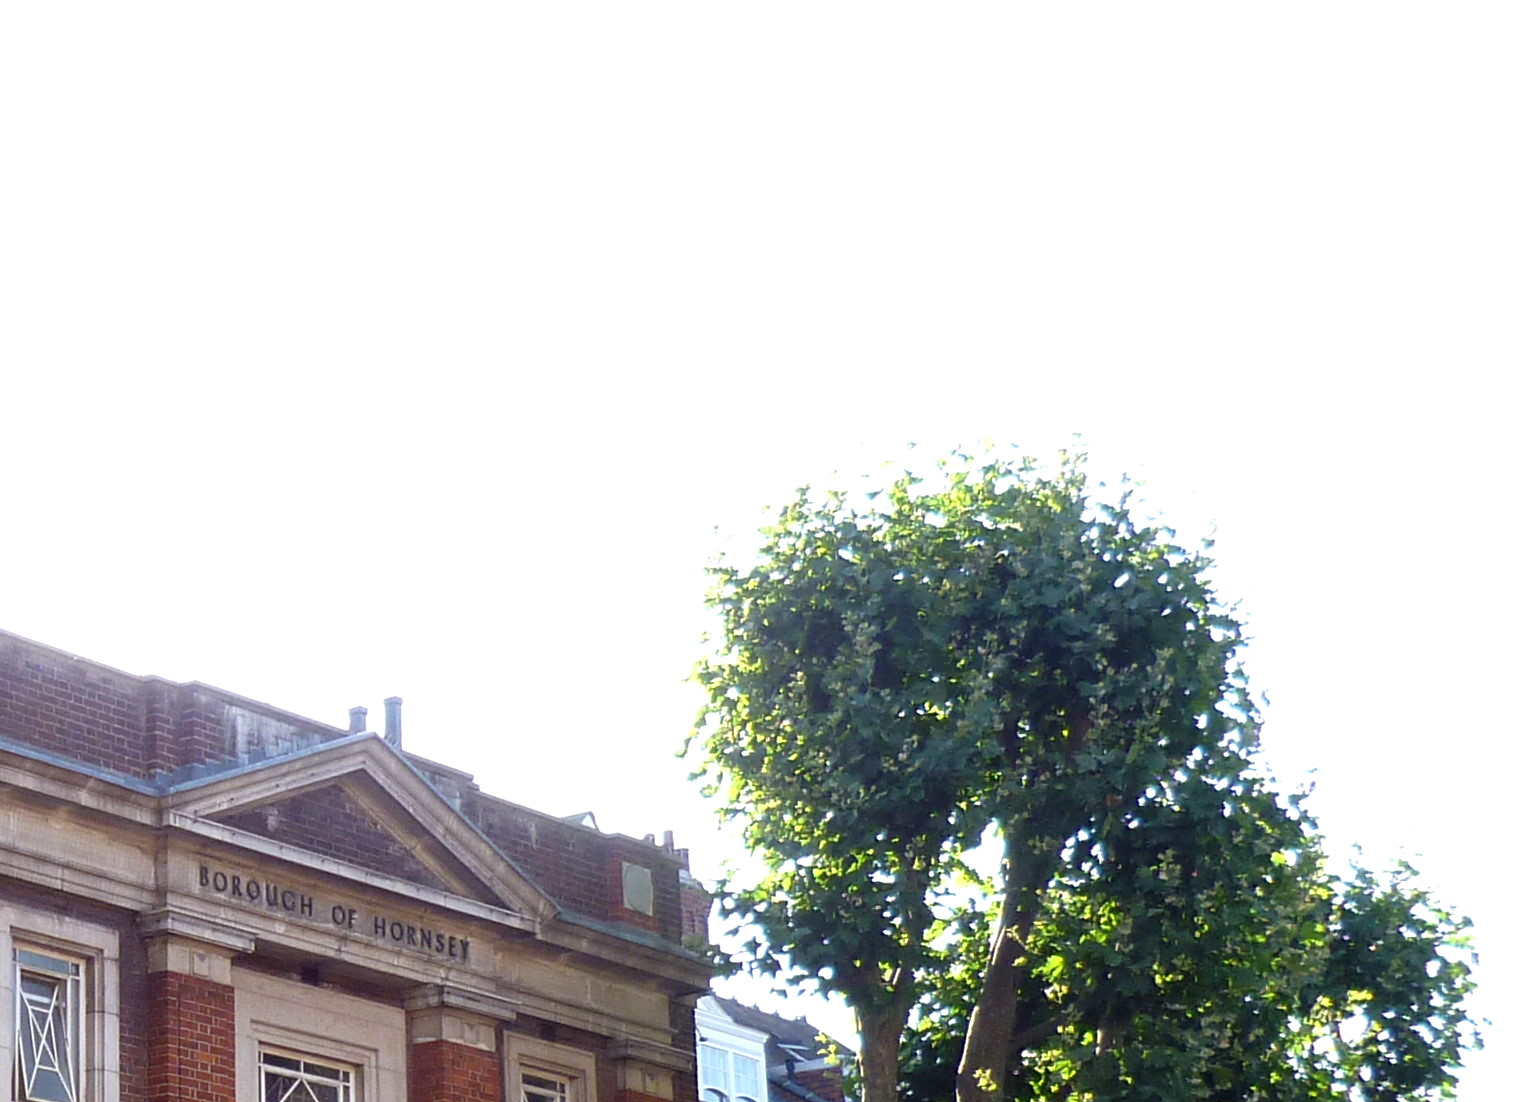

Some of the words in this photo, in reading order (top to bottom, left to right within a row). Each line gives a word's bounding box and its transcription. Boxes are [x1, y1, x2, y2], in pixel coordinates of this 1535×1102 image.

[199, 866, 313, 917] BOROUGH
[331, 905, 358, 929] OF
[374, 916, 471, 960] HORNSEY
